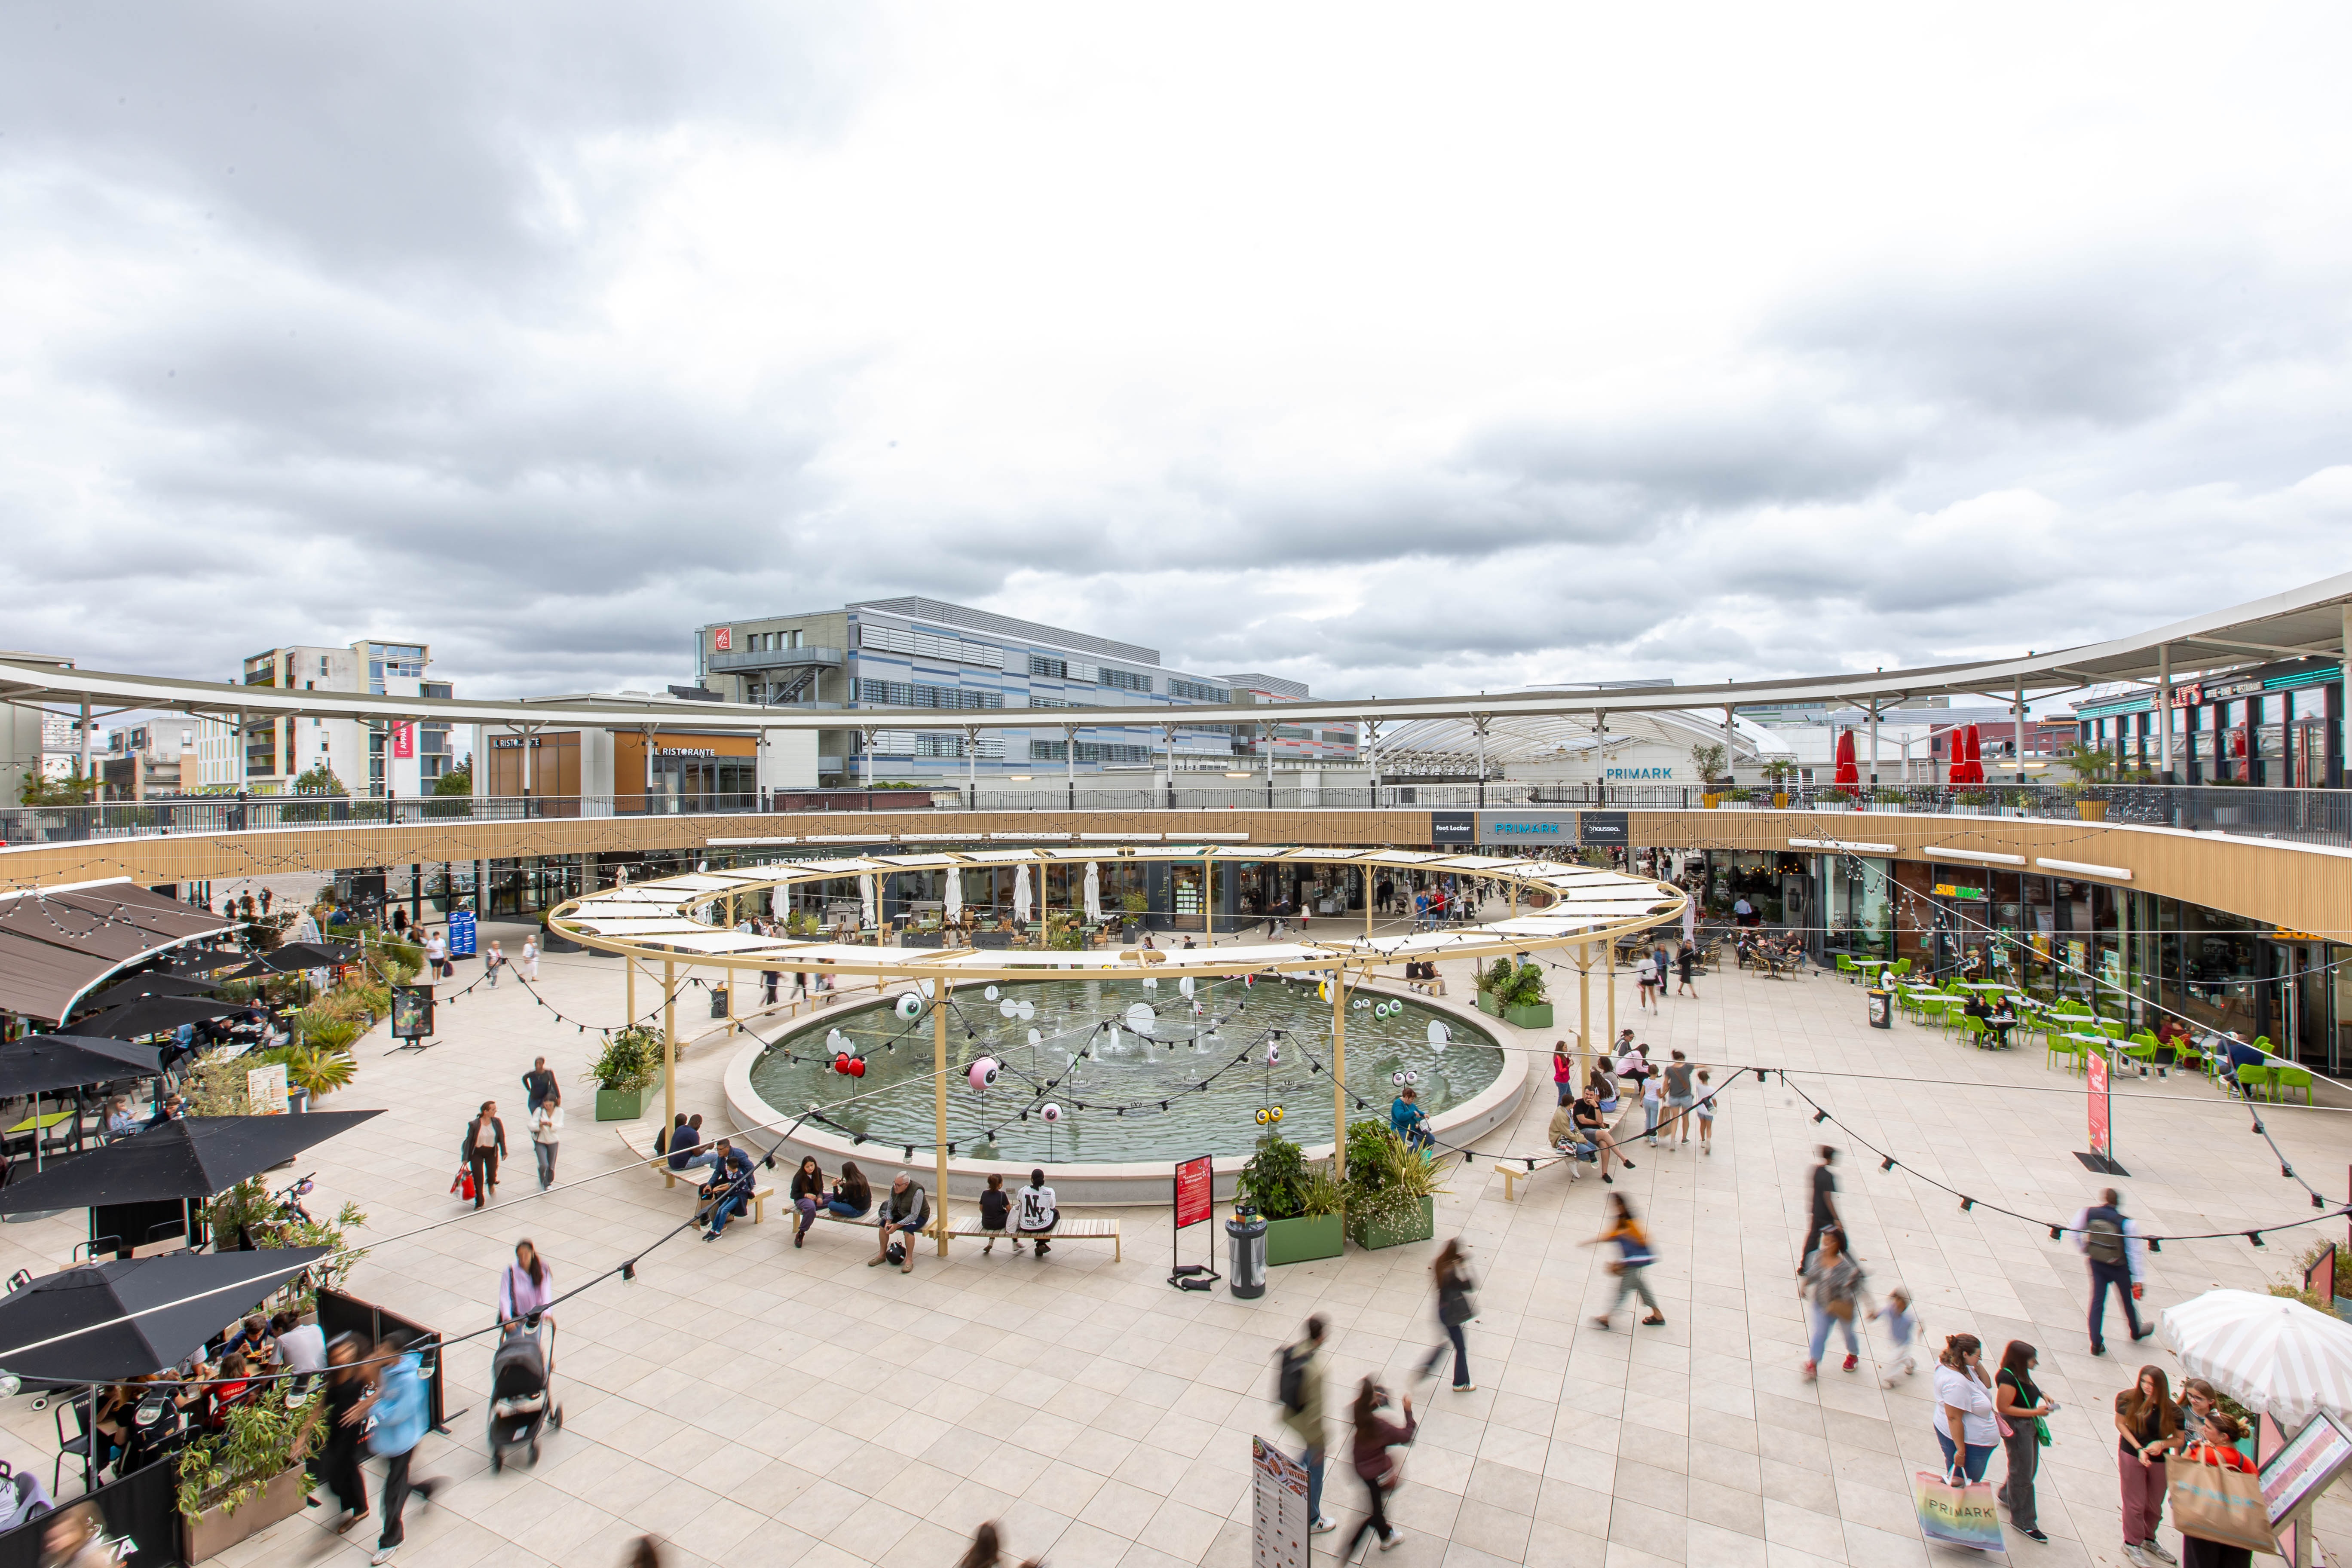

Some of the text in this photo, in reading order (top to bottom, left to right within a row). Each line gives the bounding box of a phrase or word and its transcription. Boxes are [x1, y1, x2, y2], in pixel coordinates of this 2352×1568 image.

[662, 748, 715, 756] RISTORANTE
[1607, 768, 1672, 779] PRIMARK
[1495, 824, 1559, 833] PRIMARK
[1935, 883, 1981, 900] SUBWAY
[1929, 1499, 1992, 1518] PRIMARK
